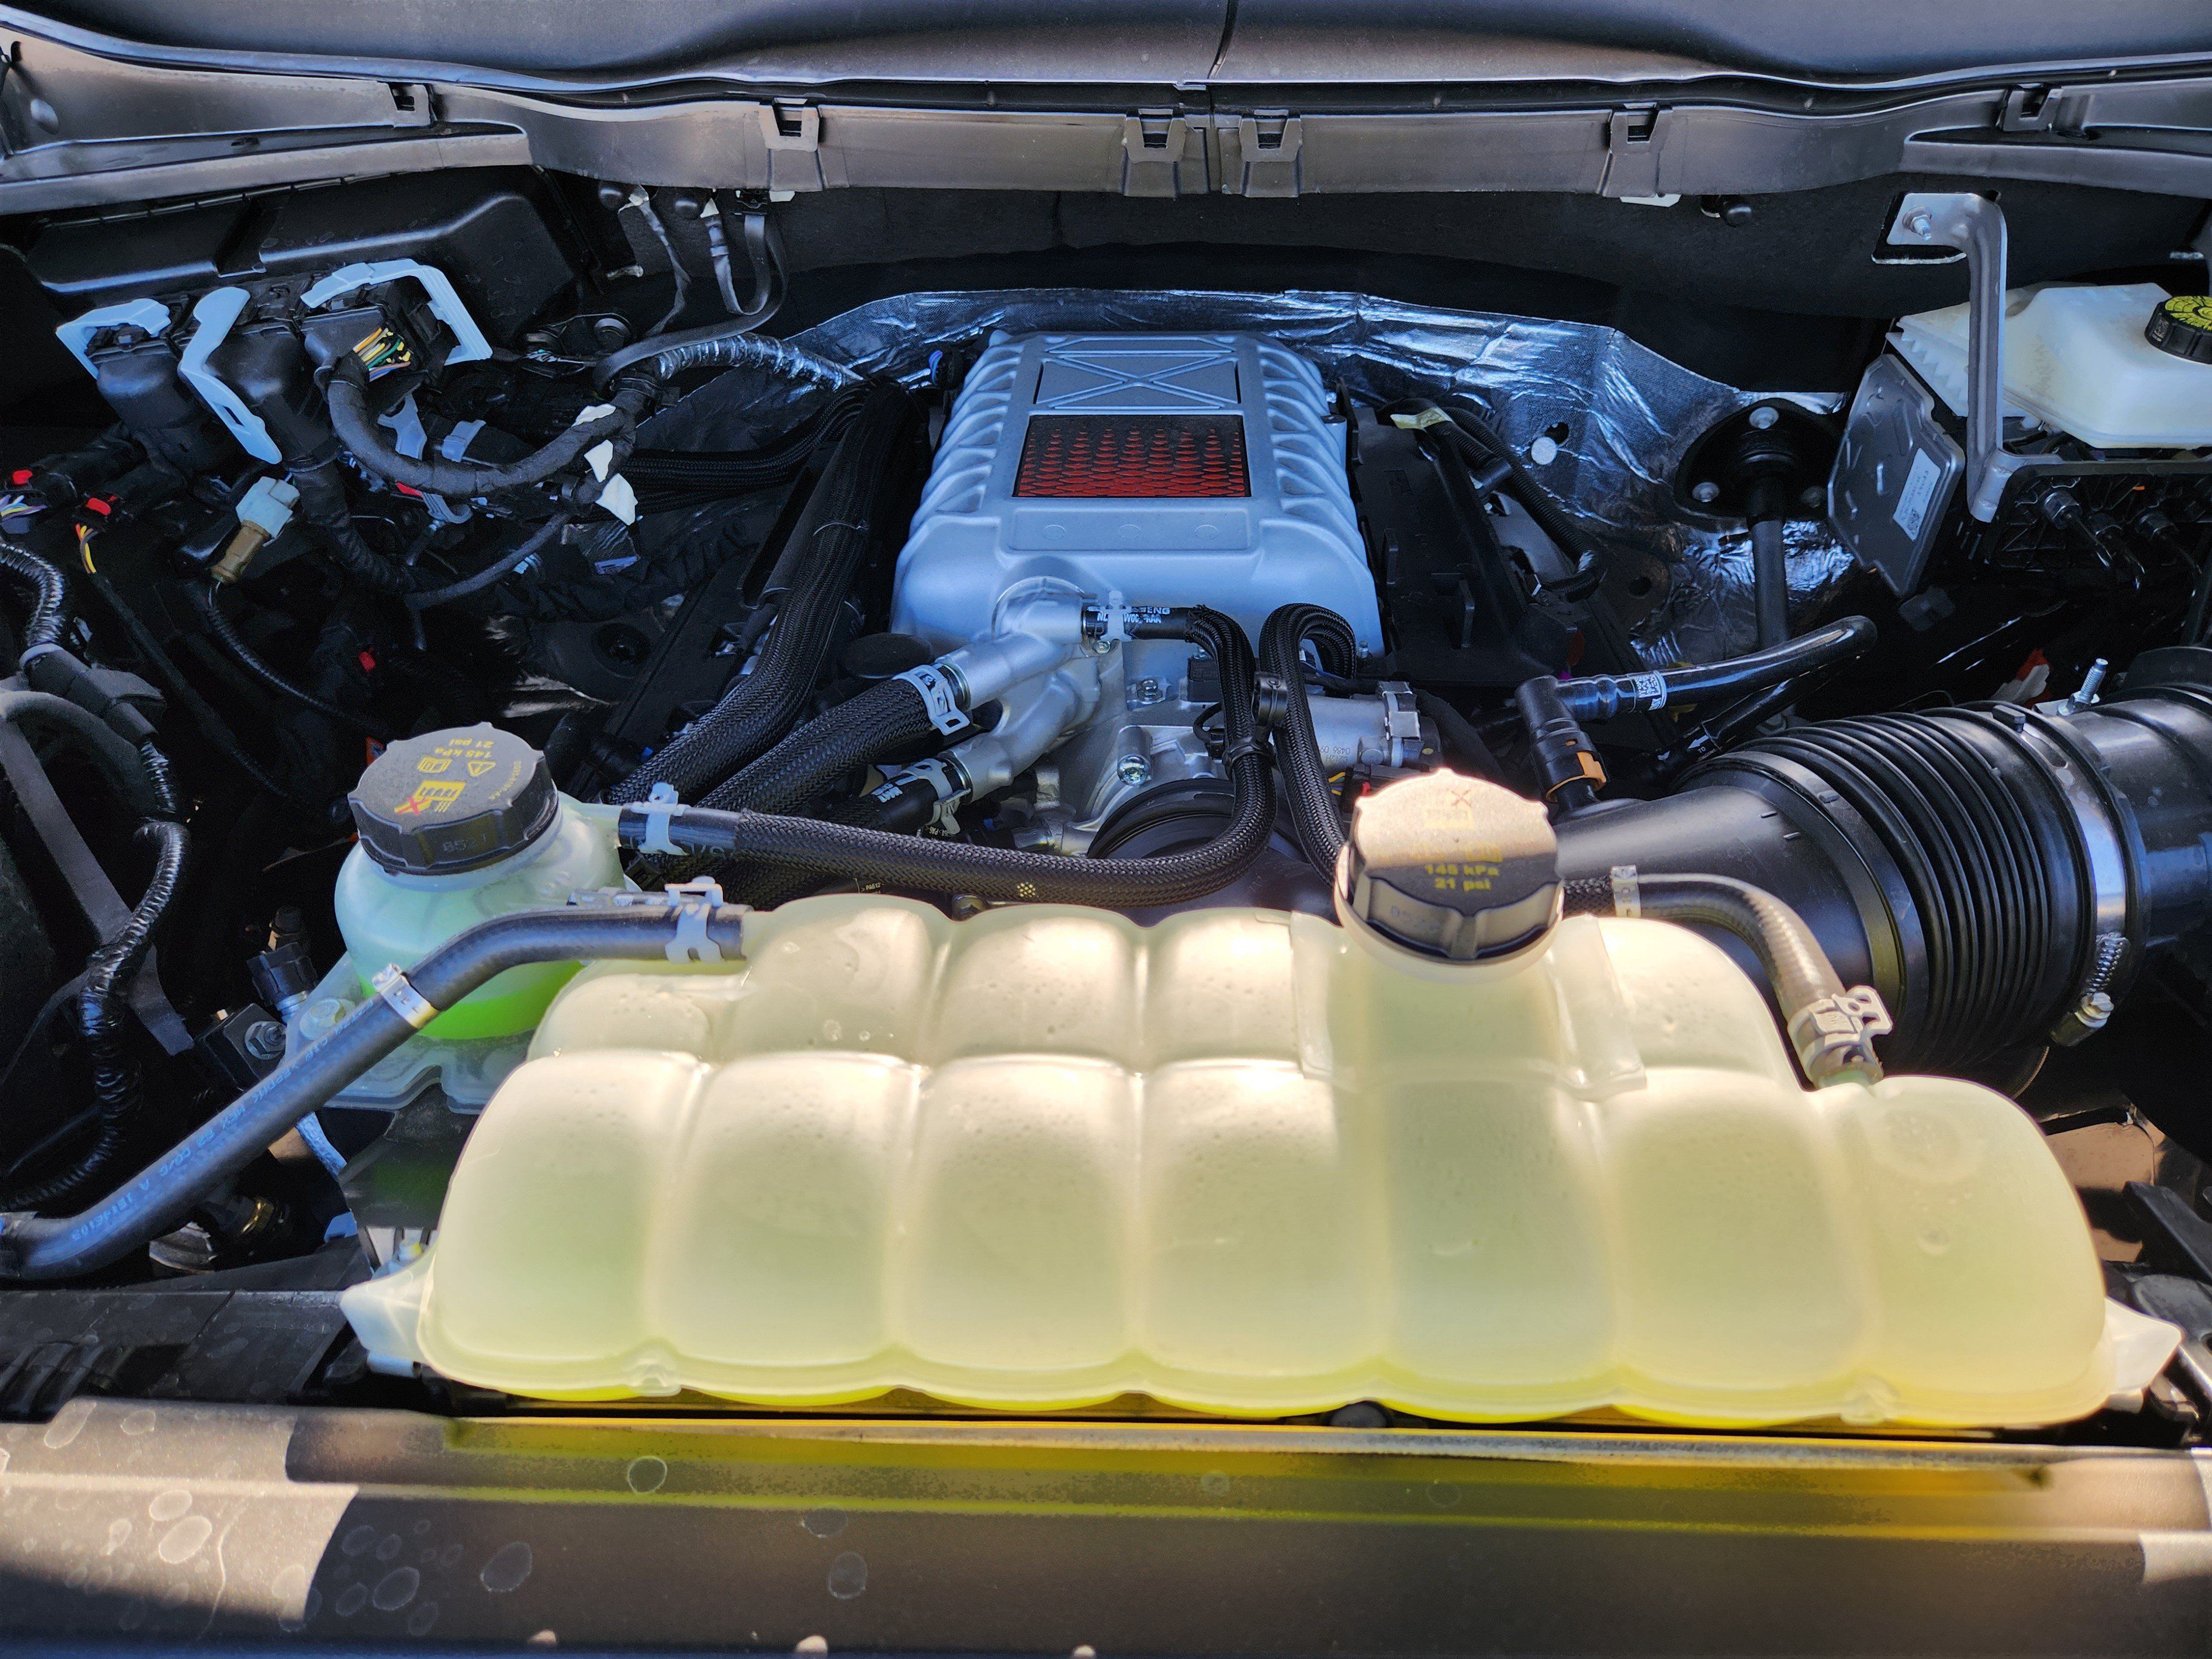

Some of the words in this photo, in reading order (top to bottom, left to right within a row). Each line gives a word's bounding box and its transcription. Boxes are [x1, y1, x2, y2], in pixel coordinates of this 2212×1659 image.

[449, 737, 473, 746] psi
[476, 740, 494, 748] 21
[435, 747, 463, 757] kPa
[465, 749, 492, 759] 145
[1425, 864, 1458, 876] 145
[1463, 864, 1500, 877] kPa
[1434, 877, 1456, 890] 21
[1463, 878, 1491, 892] psi
